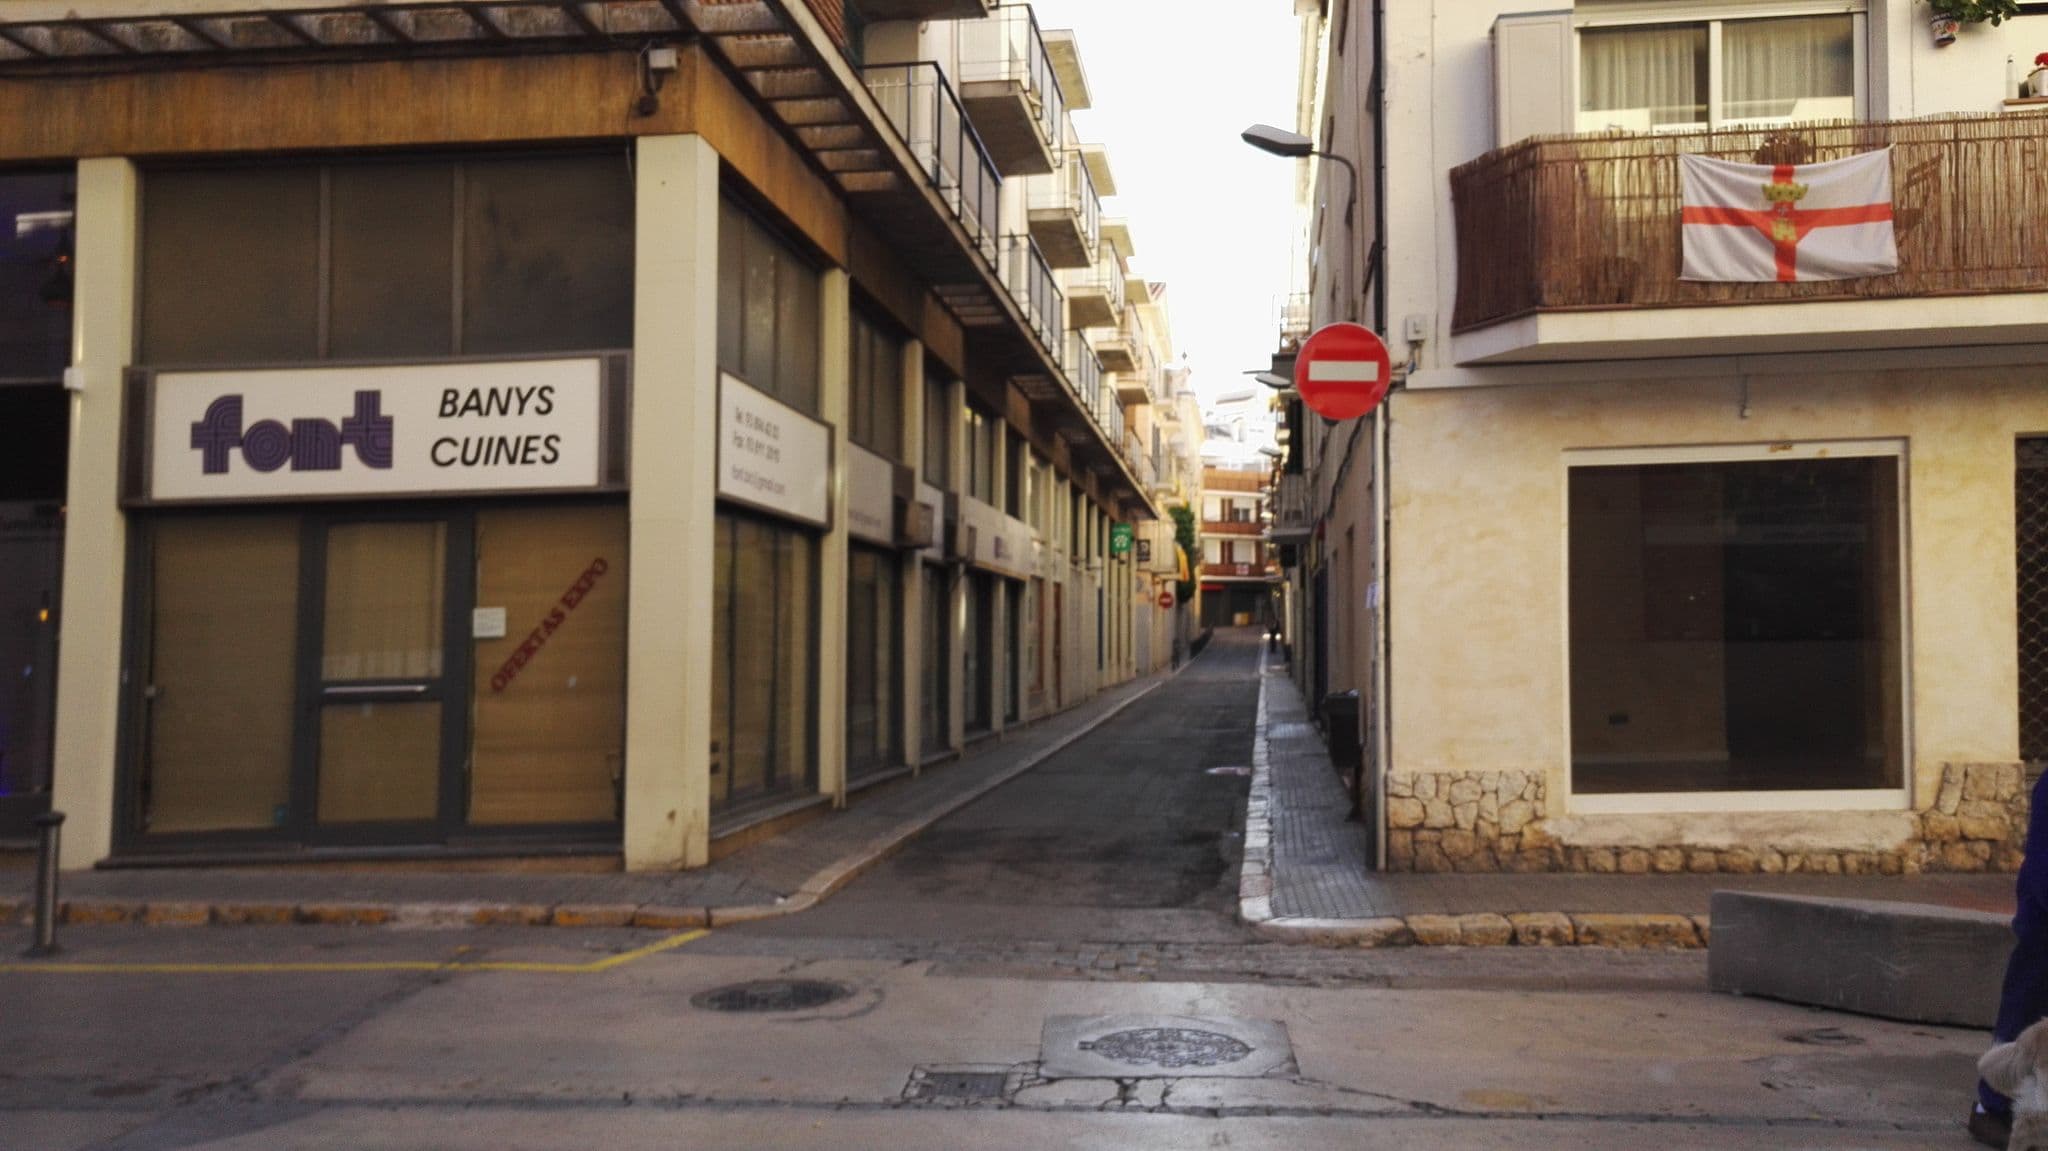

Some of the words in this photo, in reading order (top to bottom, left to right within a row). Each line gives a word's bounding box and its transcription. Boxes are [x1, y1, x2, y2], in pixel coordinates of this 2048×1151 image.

[438, 385, 555, 418] BANYS
[190, 390, 394, 475] font
[431, 434, 561, 468] CUINES
[490, 607, 566, 693] OFERTAS
[560, 556, 609, 611] EXPO
